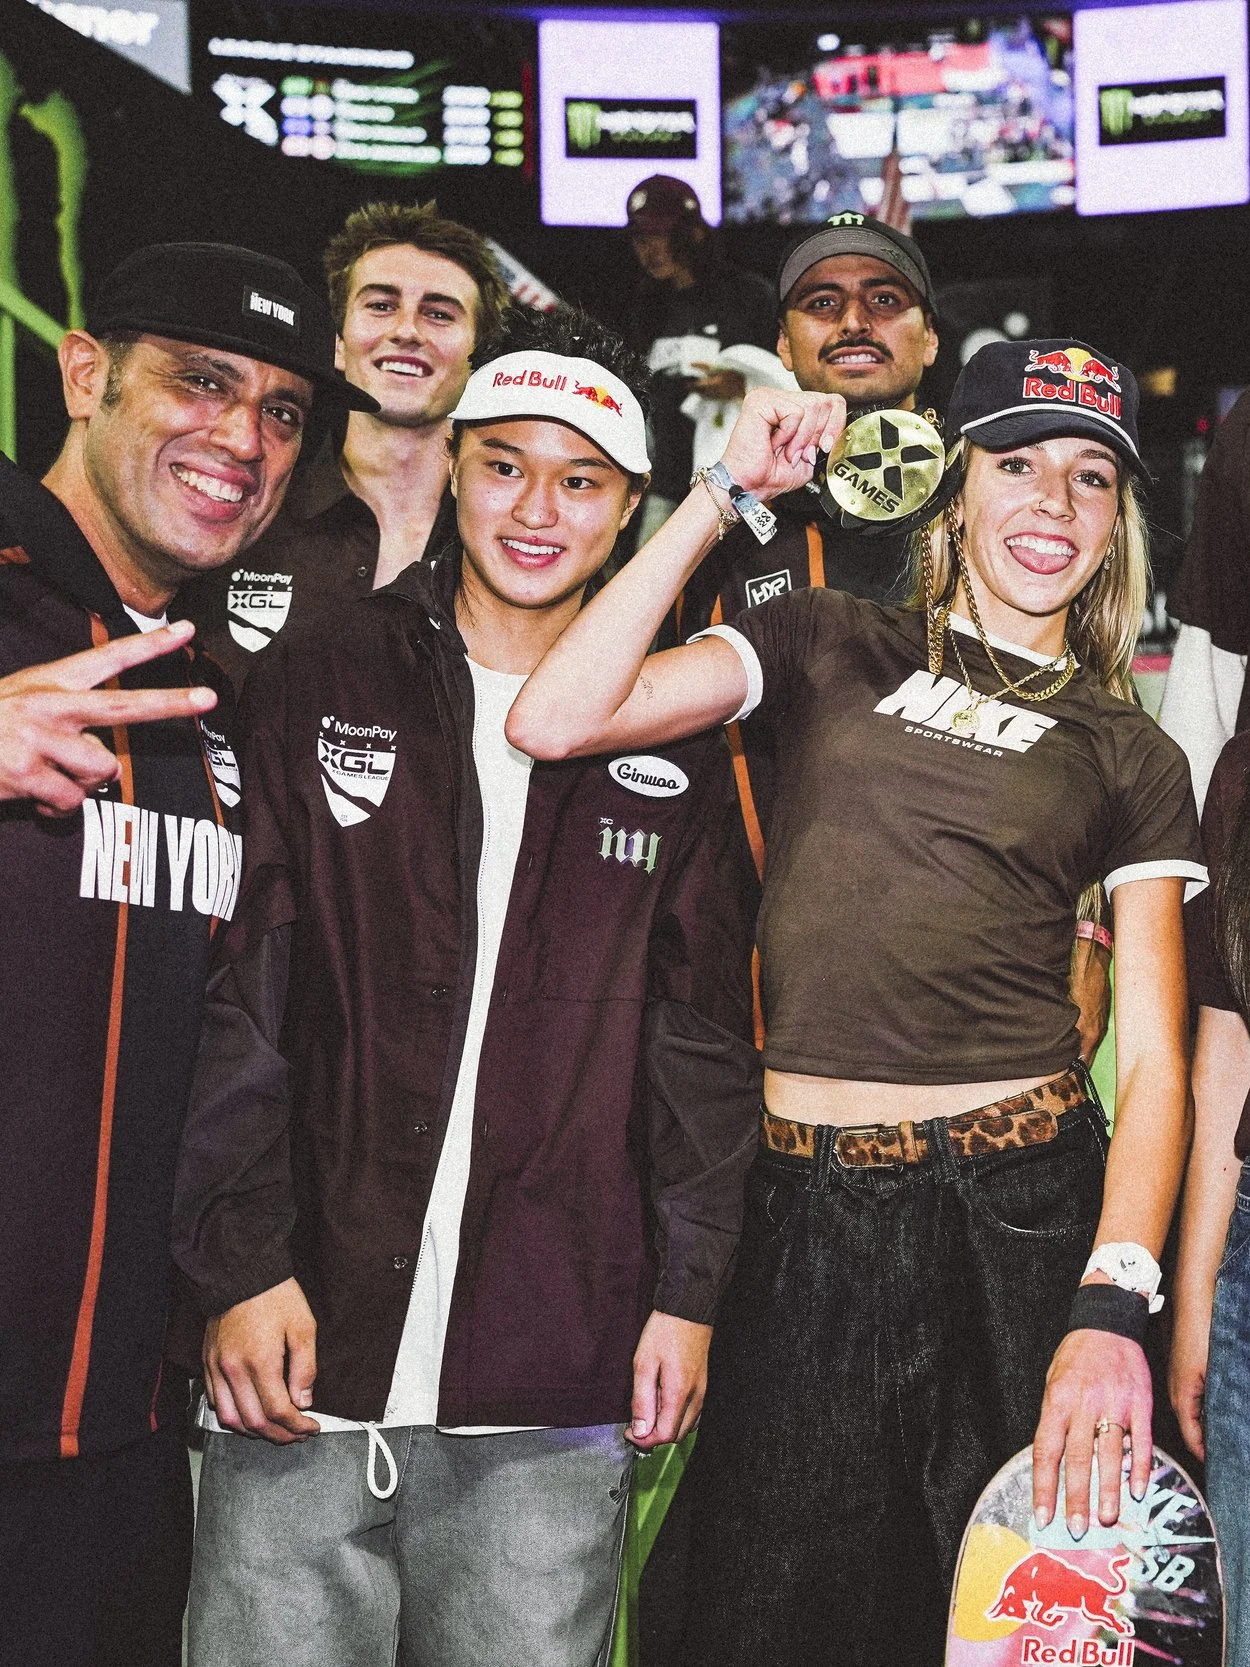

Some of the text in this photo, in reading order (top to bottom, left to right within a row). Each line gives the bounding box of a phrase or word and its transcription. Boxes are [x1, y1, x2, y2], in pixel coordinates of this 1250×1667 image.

[250, 293, 294, 326] NEW YORK
[493, 370, 567, 391] Red Bull
[1023, 377, 1121, 420] Red Bull
[833, 463, 899, 514] GAMES
[243, 571, 293, 585] MoonPay
[230, 593, 285, 609] XGL
[873, 669, 1059, 753] NIKE
[334, 721, 397, 742] MoonPay
[904, 725, 1003, 757] SPORTSWEAR
[320, 742, 390, 775] XGL
[617, 763, 680, 789] Ginwoo
[80, 798, 159, 907] NEW
[1022, 1637, 1134, 1667] Red Bull
